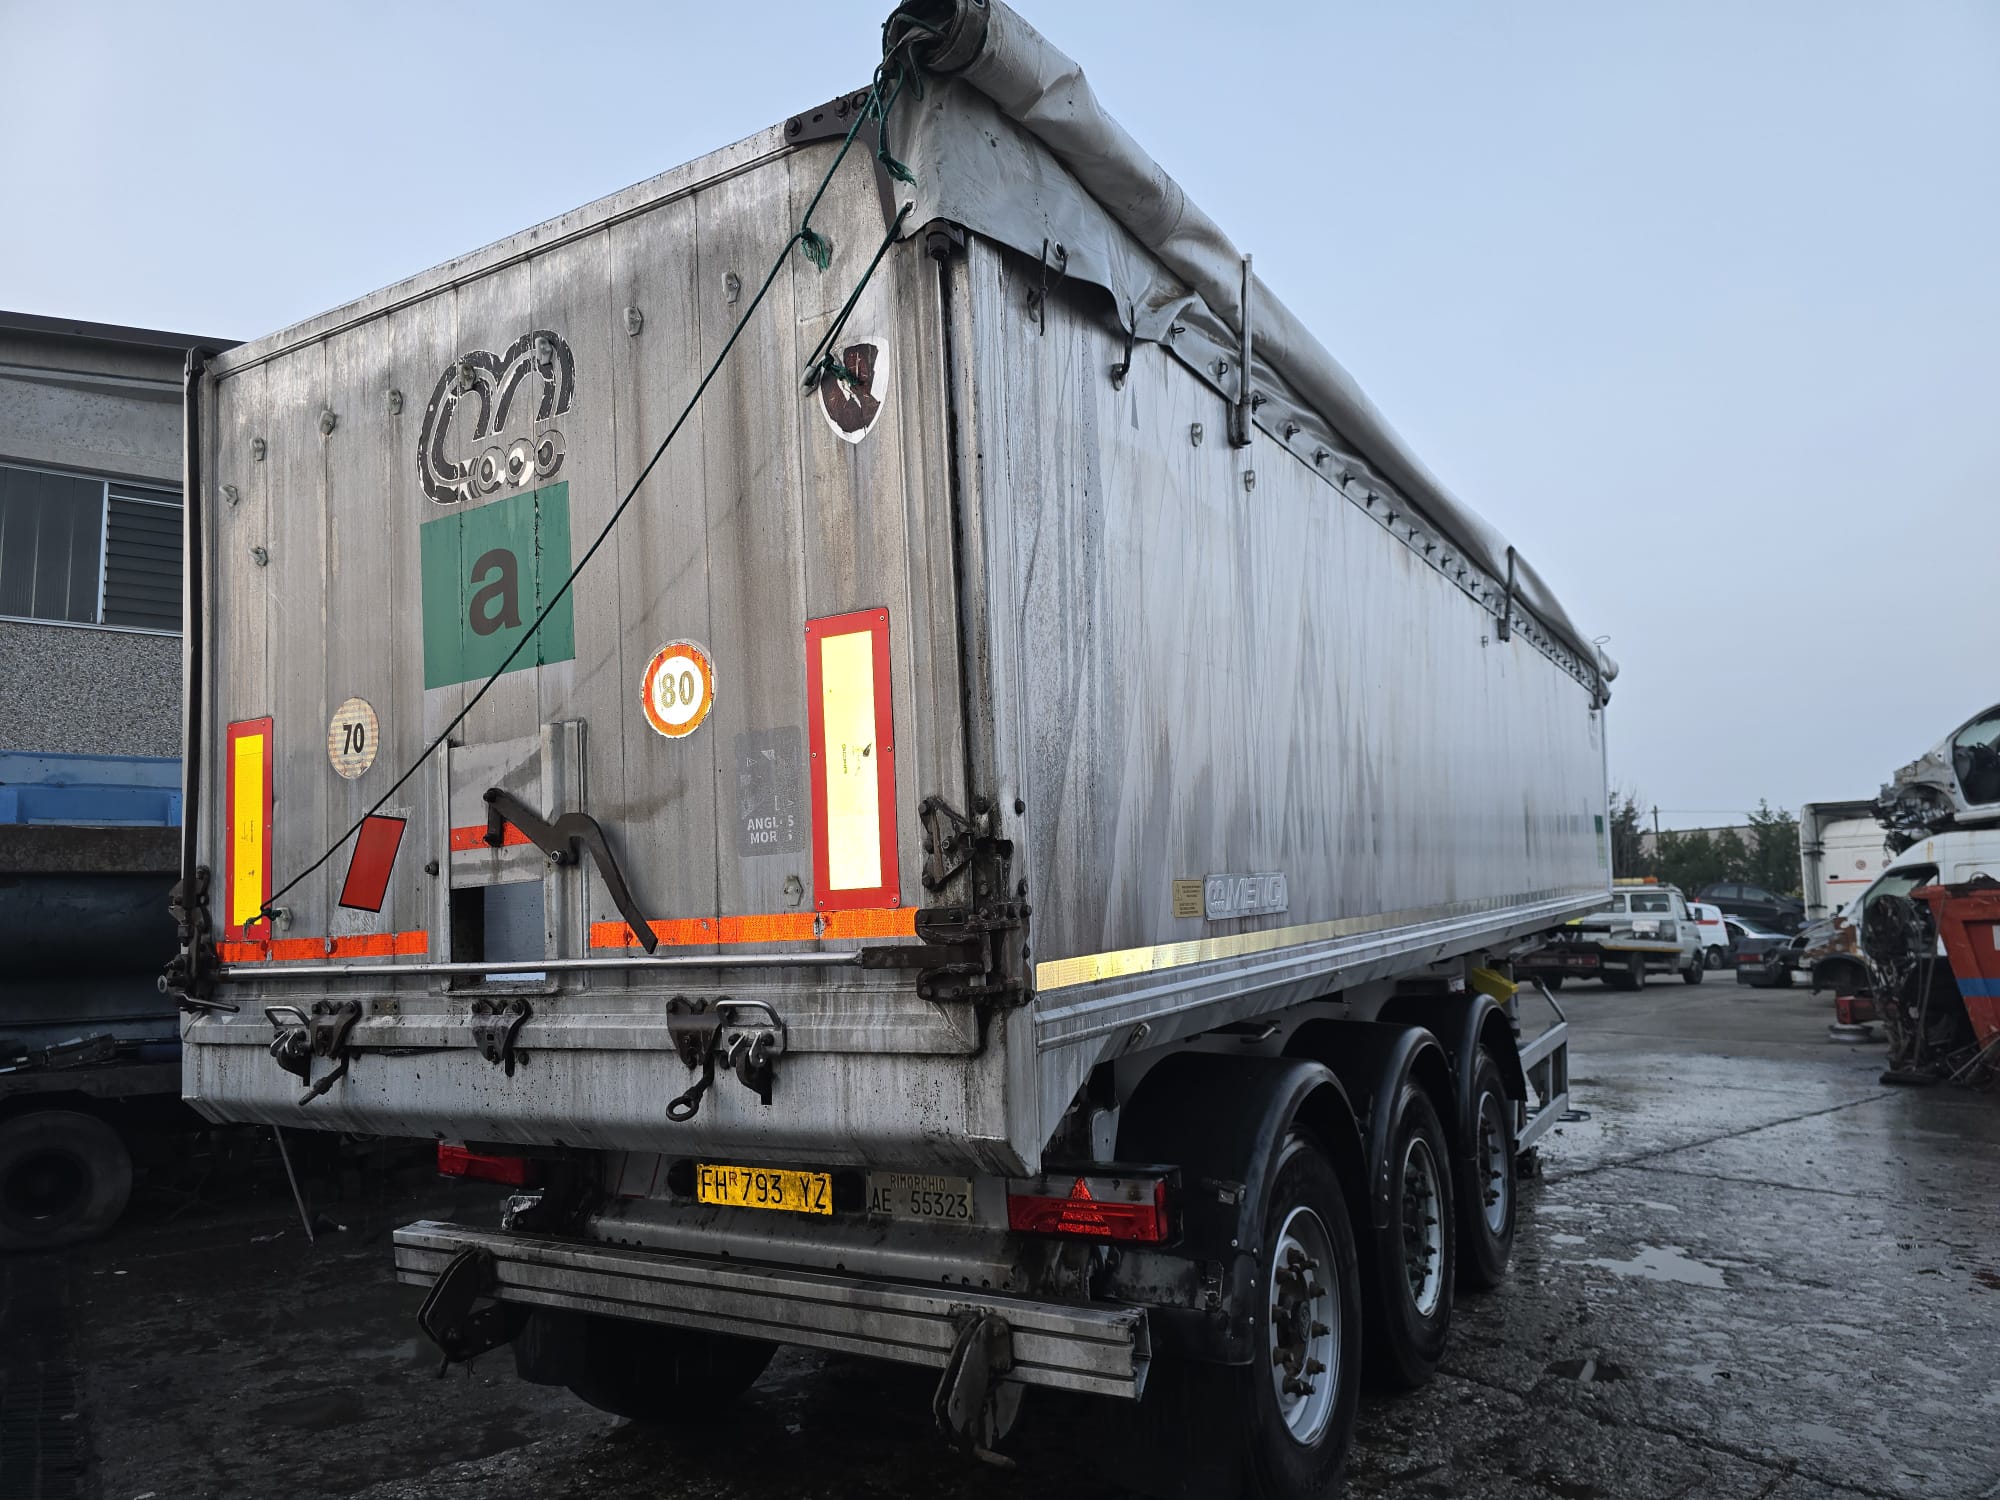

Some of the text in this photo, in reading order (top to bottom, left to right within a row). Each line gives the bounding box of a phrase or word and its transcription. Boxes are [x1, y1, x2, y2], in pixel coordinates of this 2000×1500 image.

[661, 670, 695, 709] 80
[342, 722, 365, 755] 70
[747, 814, 795, 831] ANGLS
[750, 830, 794, 845] MOR
[701, 1169, 728, 1200] FH
[741, 1172, 783, 1204] 793
[800, 1176, 827, 1209] YZ
[890, 1174, 946, 1192] RIMORCHIO
[872, 1187, 968, 1219] AE 55323
